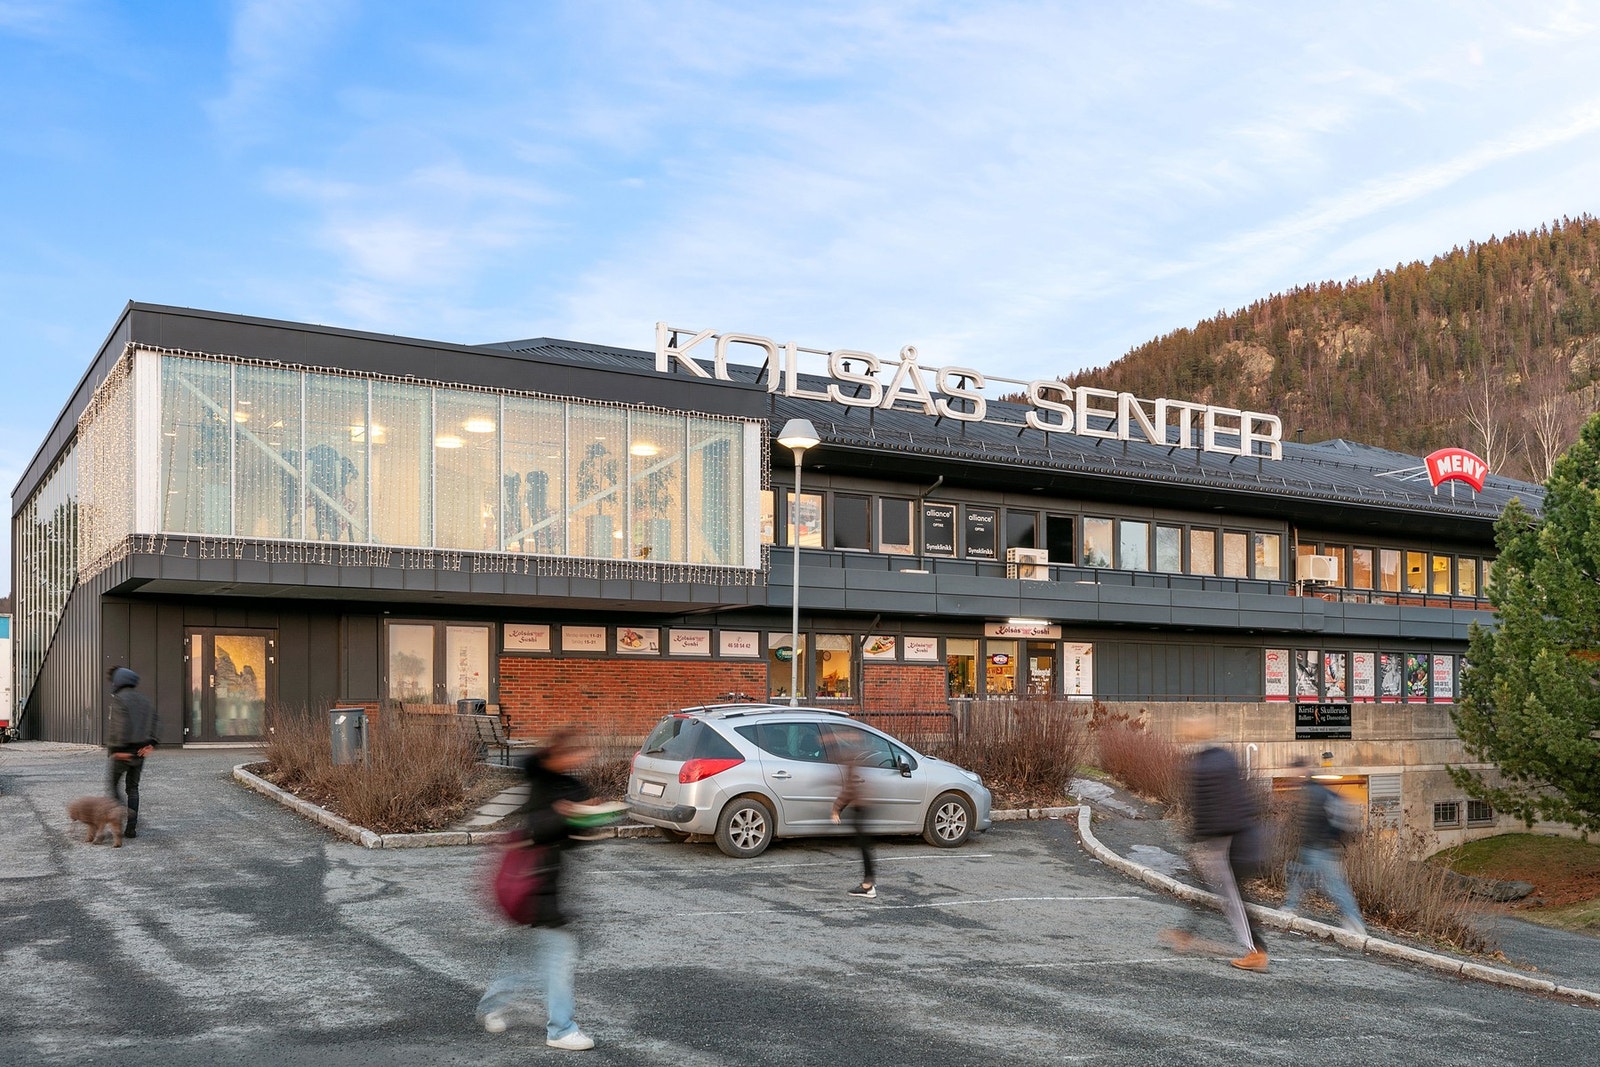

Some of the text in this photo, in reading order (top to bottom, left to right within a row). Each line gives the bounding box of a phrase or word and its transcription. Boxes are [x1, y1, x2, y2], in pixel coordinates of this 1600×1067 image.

[655, 321, 1283, 461] KOLSÅS SENTER
[1436, 455, 1486, 480] MENY
[995, 626, 1050, 636] Kolsås Sushi
[1298, 705, 1314, 713] Kirsti
